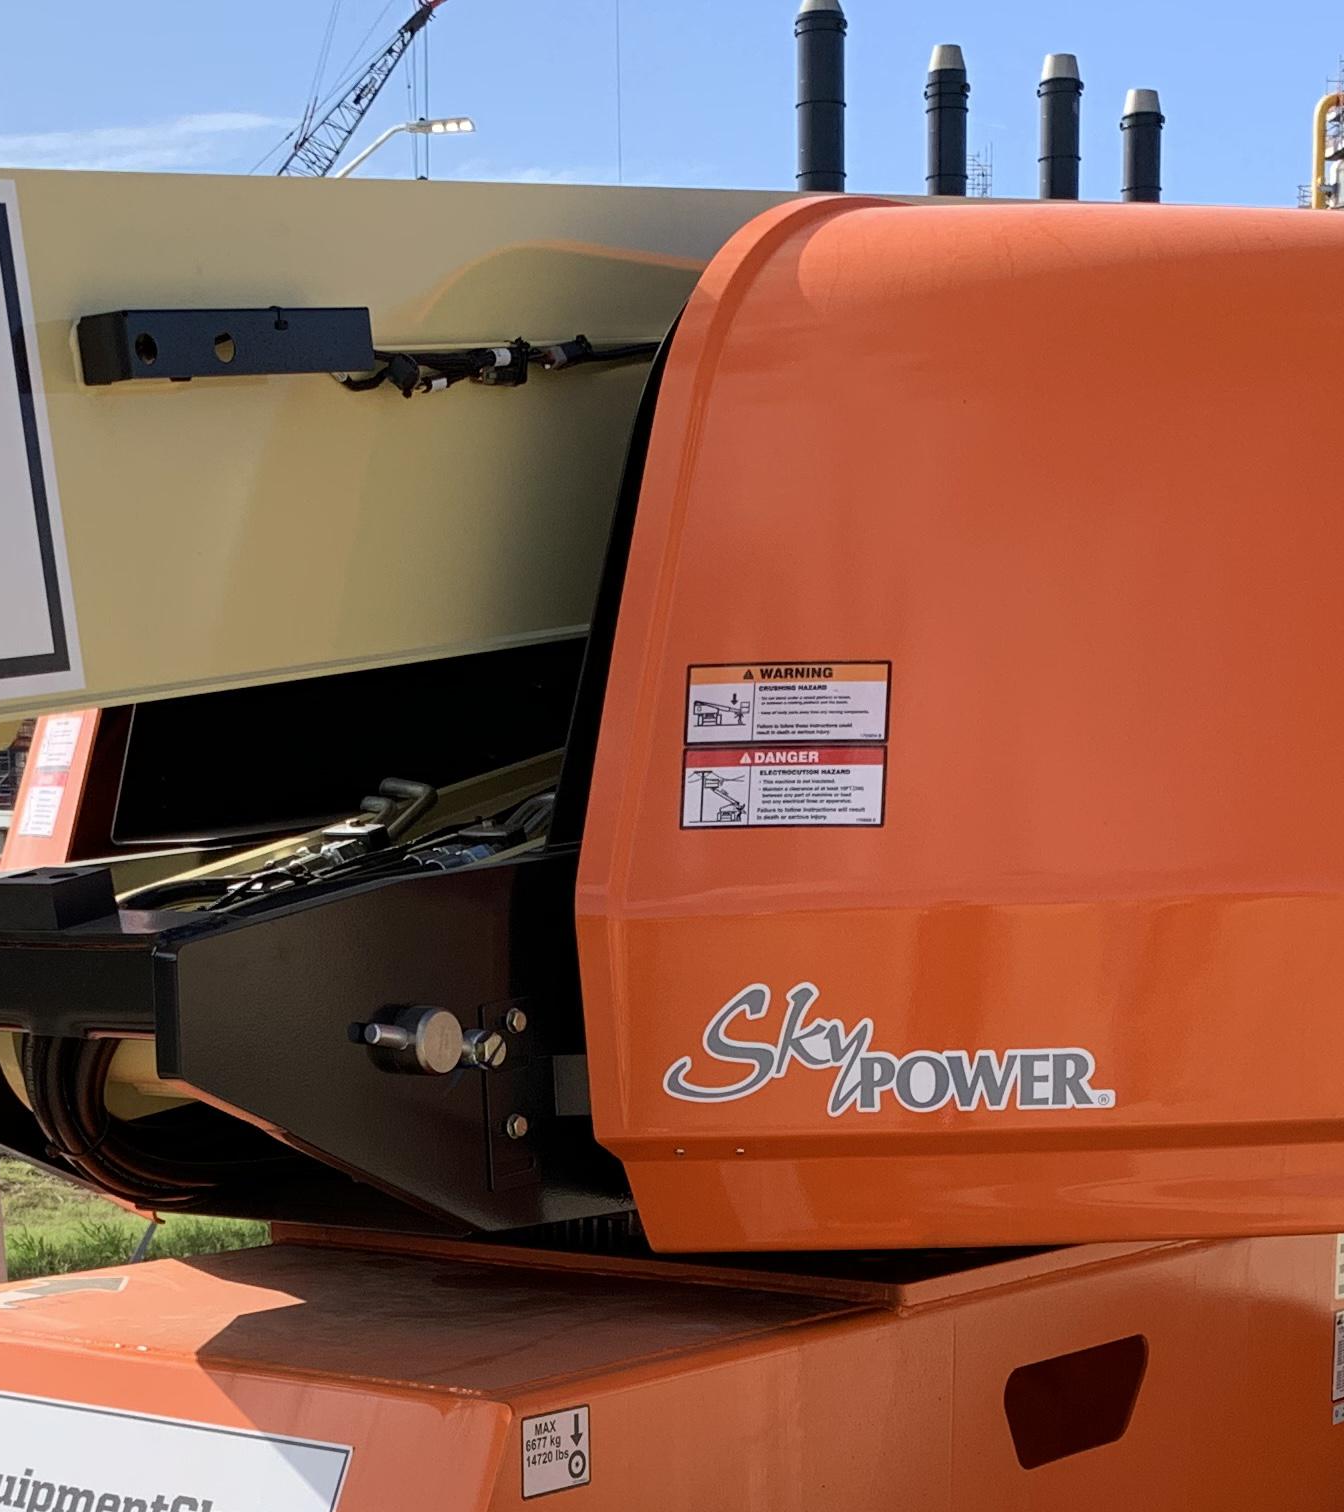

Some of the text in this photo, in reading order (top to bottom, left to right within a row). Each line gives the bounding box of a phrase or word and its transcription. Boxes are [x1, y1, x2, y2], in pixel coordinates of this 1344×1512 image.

[760, 667, 833, 679] WARNING
[754, 751, 819, 764] DANGER
[663, 982, 1096, 1117] Sky POWER
[535, 1420, 556, 1435] MAX
[526, 1435, 561, 1452] 6677 kg
[526, 1449, 569, 1467] 14720 lbs
